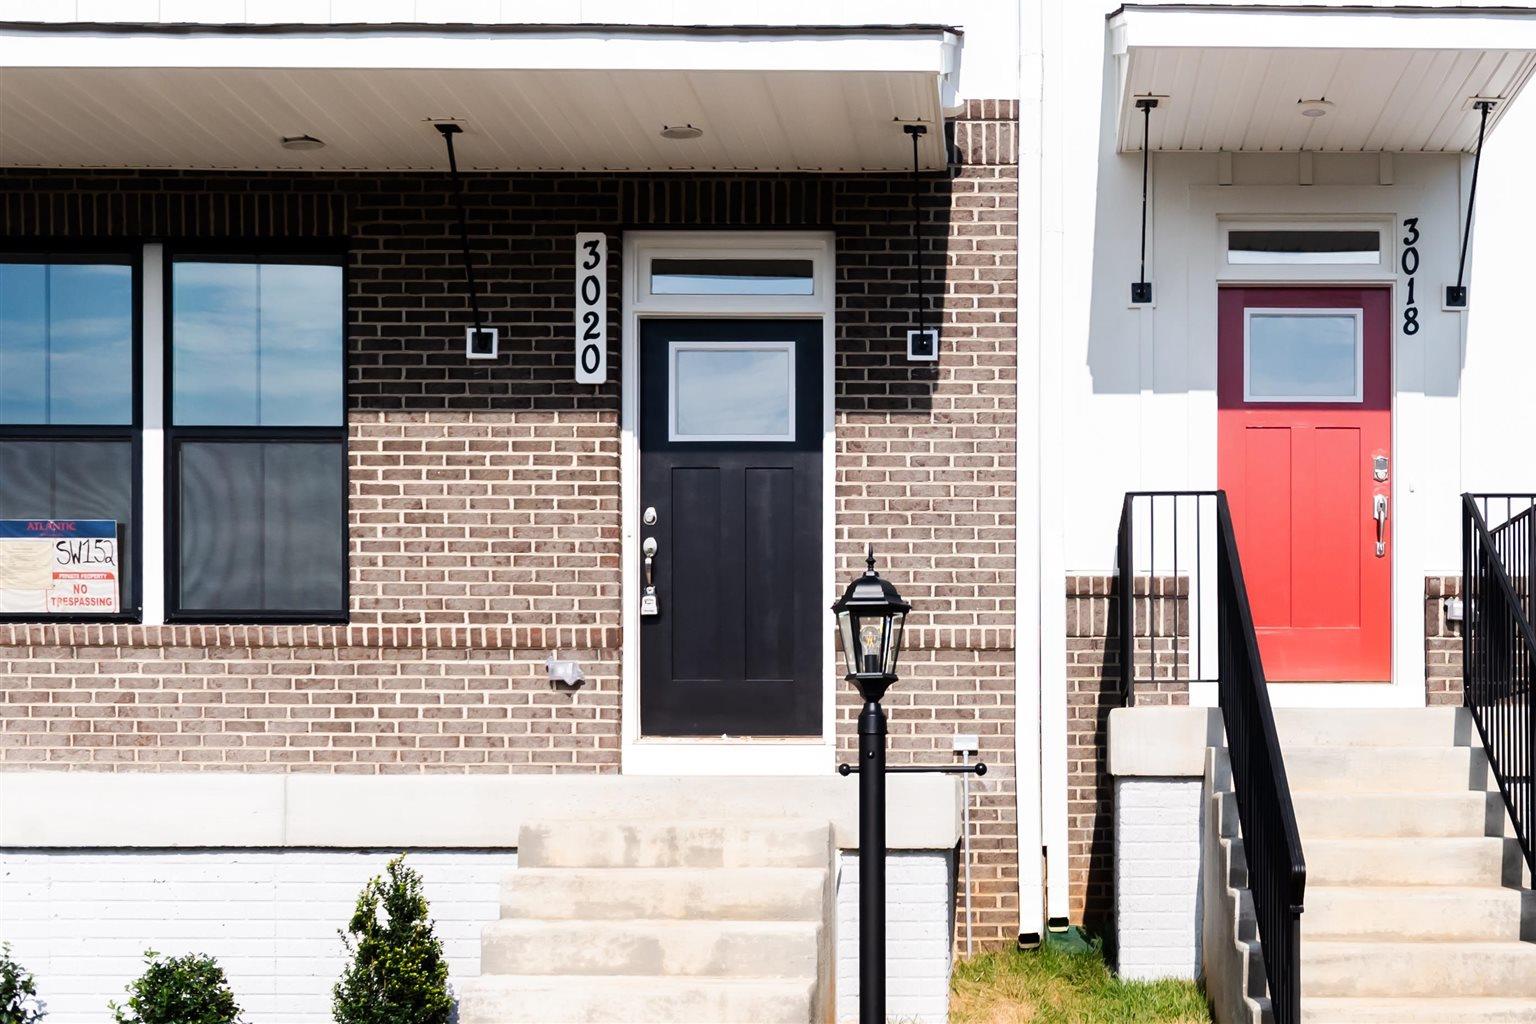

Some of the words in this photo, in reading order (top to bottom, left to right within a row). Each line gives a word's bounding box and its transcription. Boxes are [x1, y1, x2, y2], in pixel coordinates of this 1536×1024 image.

[1402, 217, 1419, 335] 3018
[581, 240, 600, 374] 3020
[26, 522, 76, 531] ATLANTIC
[56, 539, 116, 566] SW152
[73, 584, 88, 594] NO
[51, 597, 112, 606] TRESPASSING
